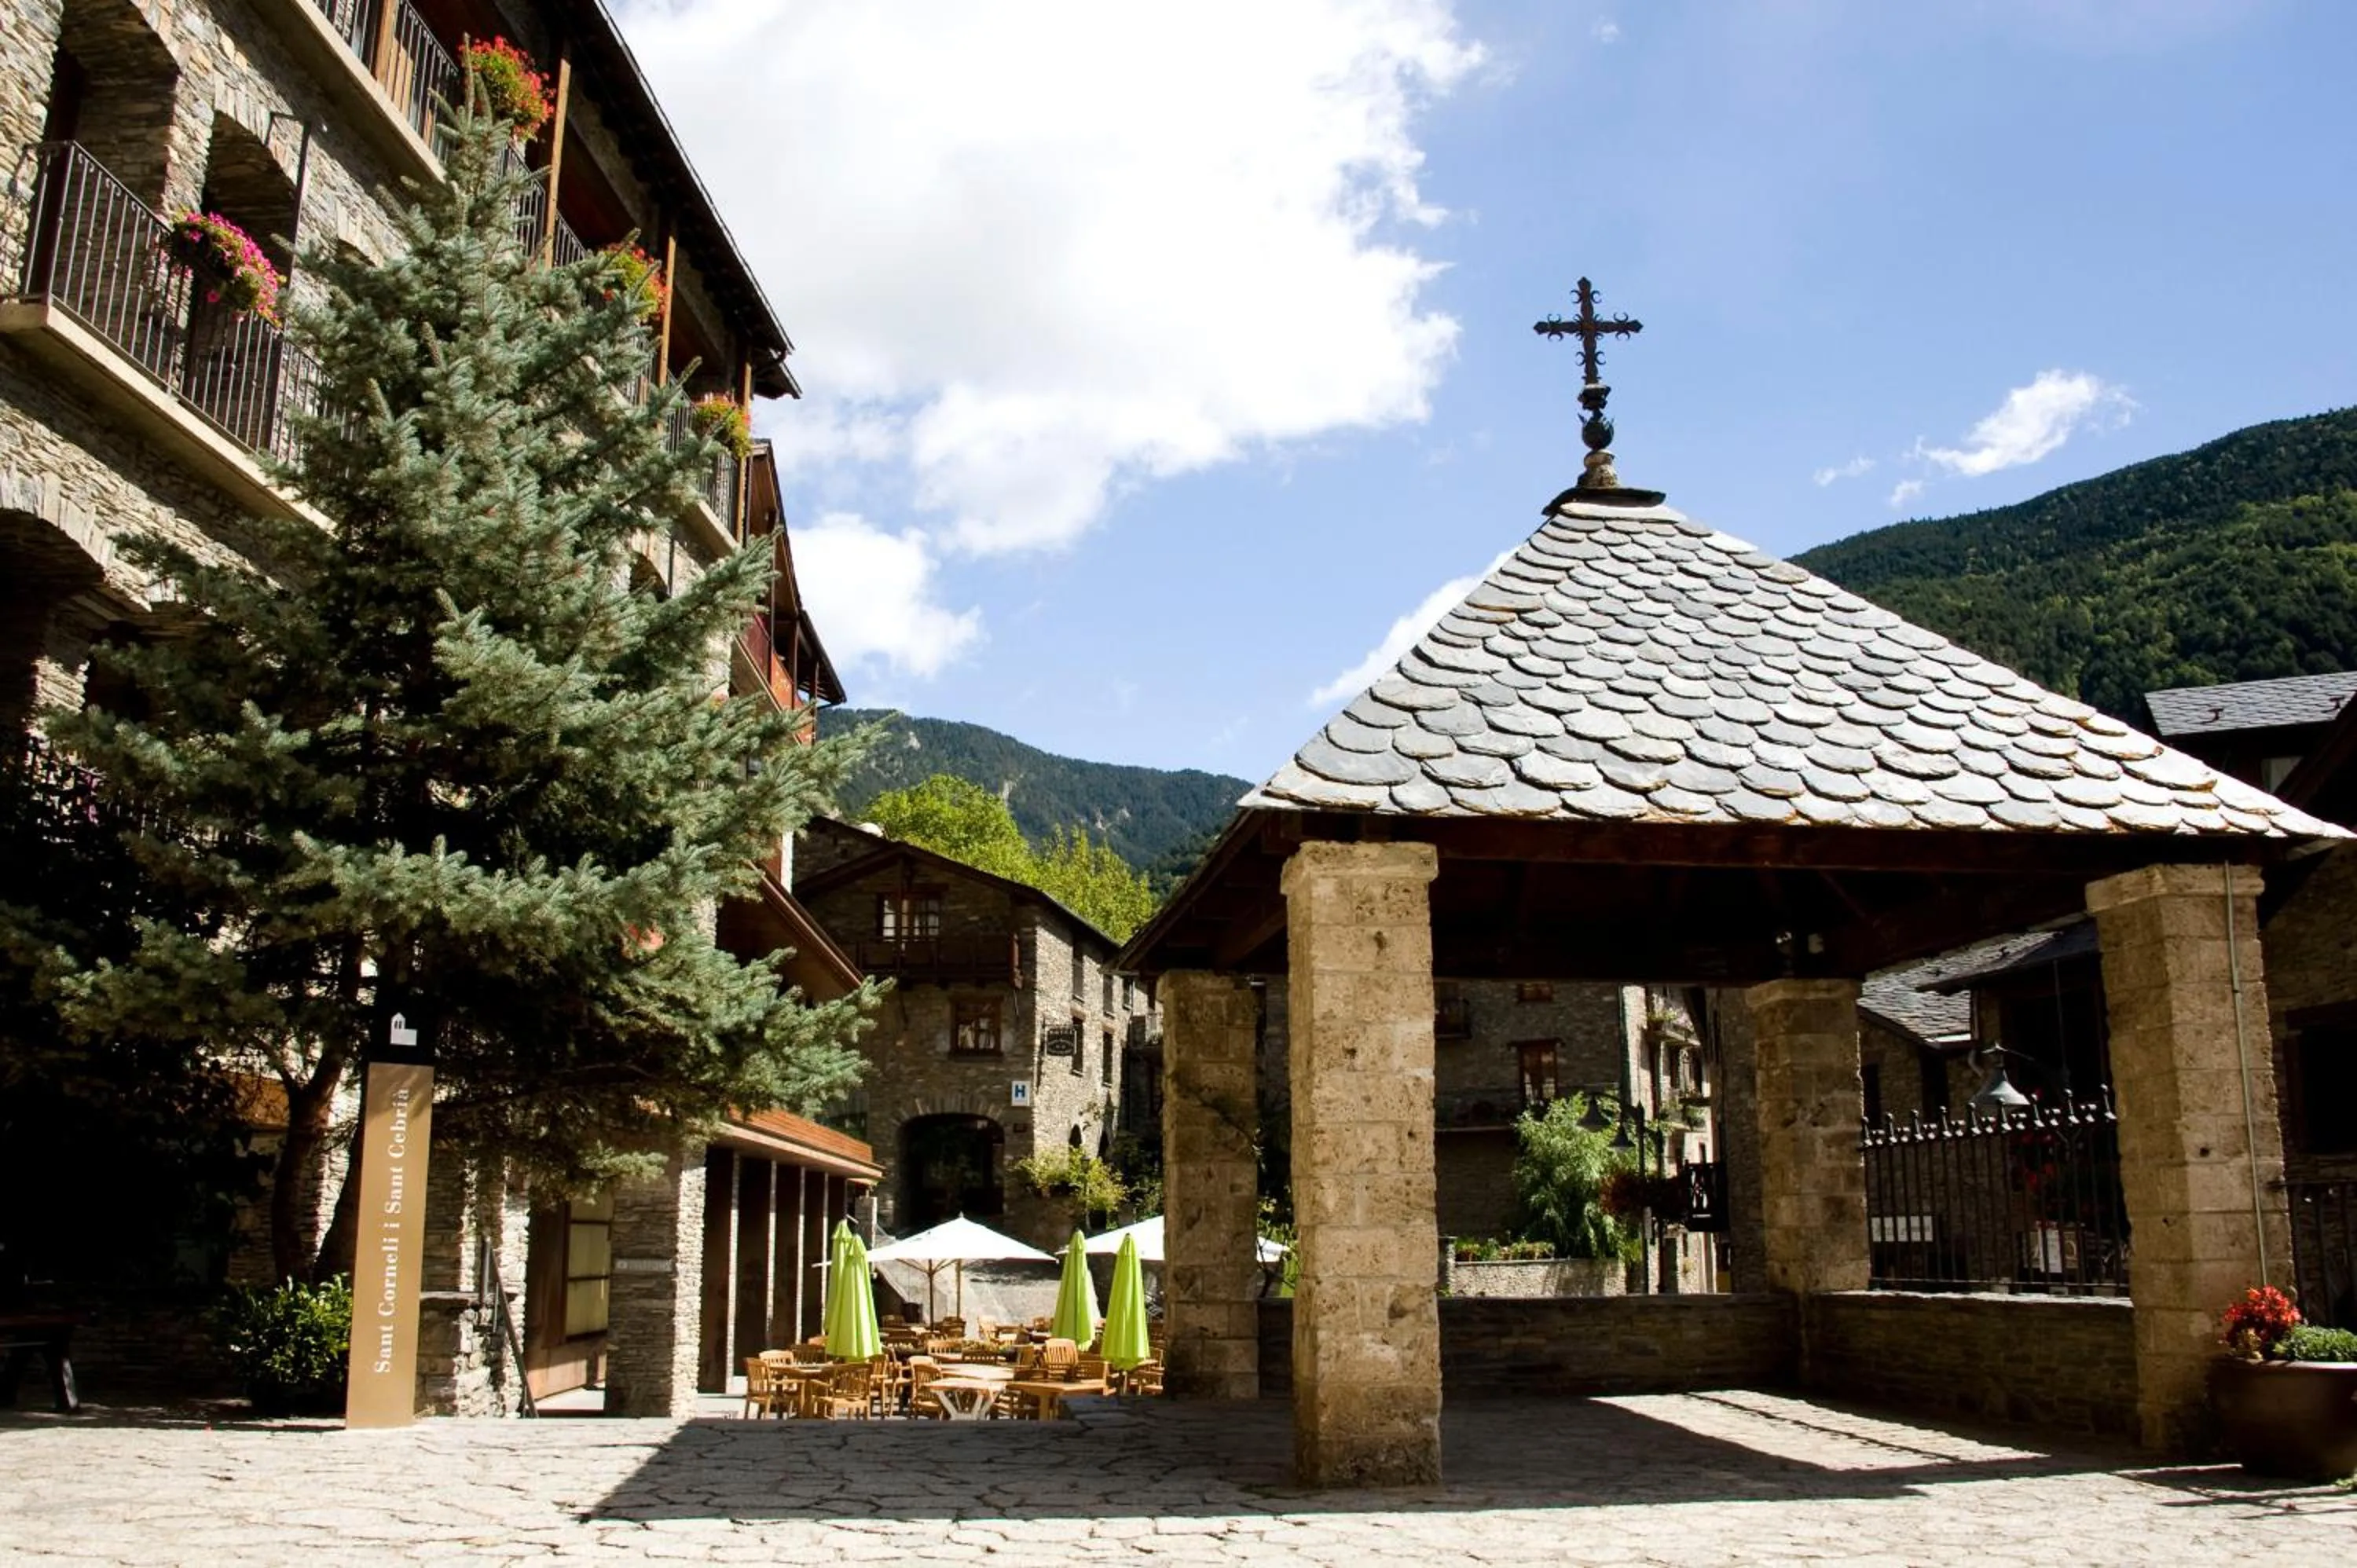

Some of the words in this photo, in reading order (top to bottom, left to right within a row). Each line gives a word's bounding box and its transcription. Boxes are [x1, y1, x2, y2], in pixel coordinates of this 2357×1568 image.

[1014, 1084, 1025, 1097] H
[388, 1087, 410, 1159] Cebrià
[384, 1166, 403, 1214] Sant
[378, 1236, 399, 1317] Corneli
[375, 1324, 394, 1373] Sant
